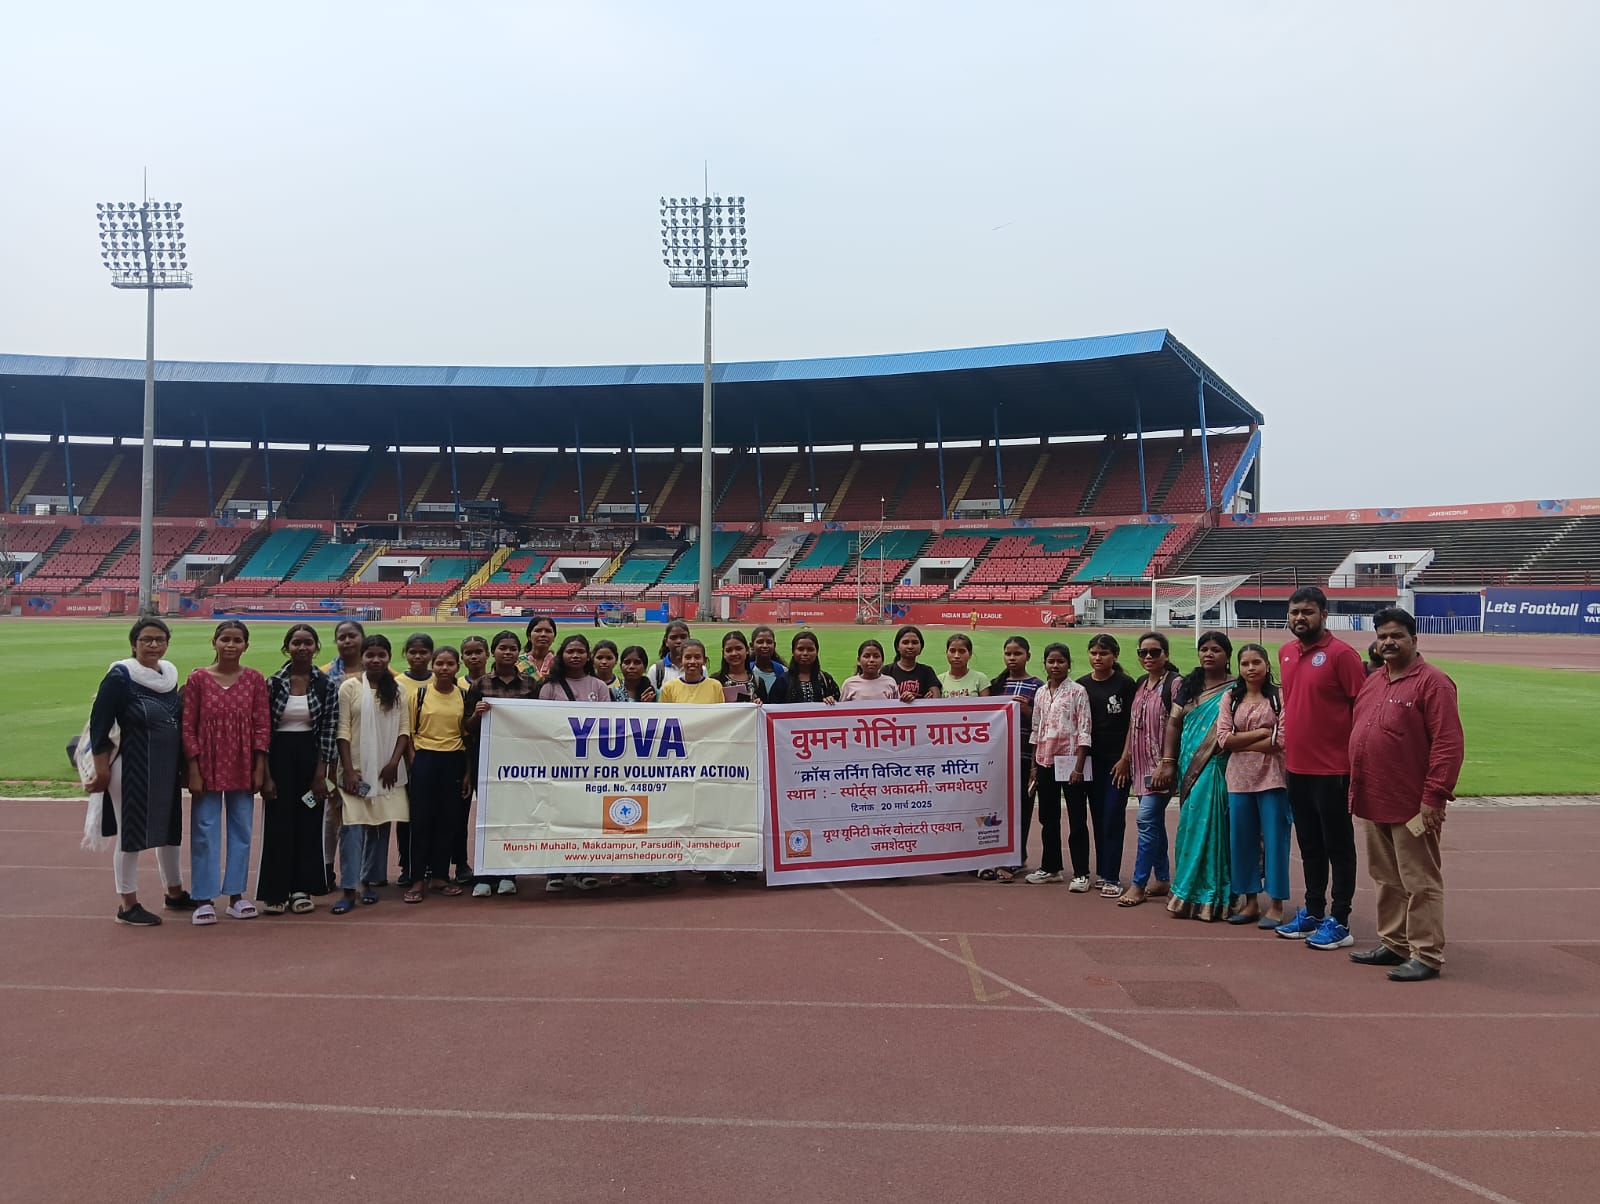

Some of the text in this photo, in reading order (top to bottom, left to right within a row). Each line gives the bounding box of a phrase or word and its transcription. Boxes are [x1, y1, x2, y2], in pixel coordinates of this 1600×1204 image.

[1486, 601, 1580, 616] Lets Football
[568, 717, 687, 759] YUVA
[791, 716, 990, 759] वुमन गेनिंग ग्राउंड
[497, 765, 750, 780] (YOUTH UNITY FOR VOLUNTARY ACTION)
[872, 763, 912, 779] विजिट
[915, 764, 936, 778] सह
[941, 759, 979, 776] मीटिंग
[585, 783, 667, 794] Regd. No. 4480/97
[786, 788, 816, 800] स्थान
[840, 782, 877, 800] स्पोर्ट्स
[935, 778, 988, 796] जमशेदपुर
[851, 800, 932, 812] दिनांक 20 मार्च 2025
[822, 829, 839, 843] यूथ
[841, 825, 870, 842] यूनिटी
[872, 824, 892, 837] फॉर
[503, 840, 741, 852] Munshi Muhalla, Makdampur, Parsudih, Jamshedpur
[870, 838, 918, 852] जमशेदपुर
[564, 851, 683, 863] www.yuvajamshedpur.org
